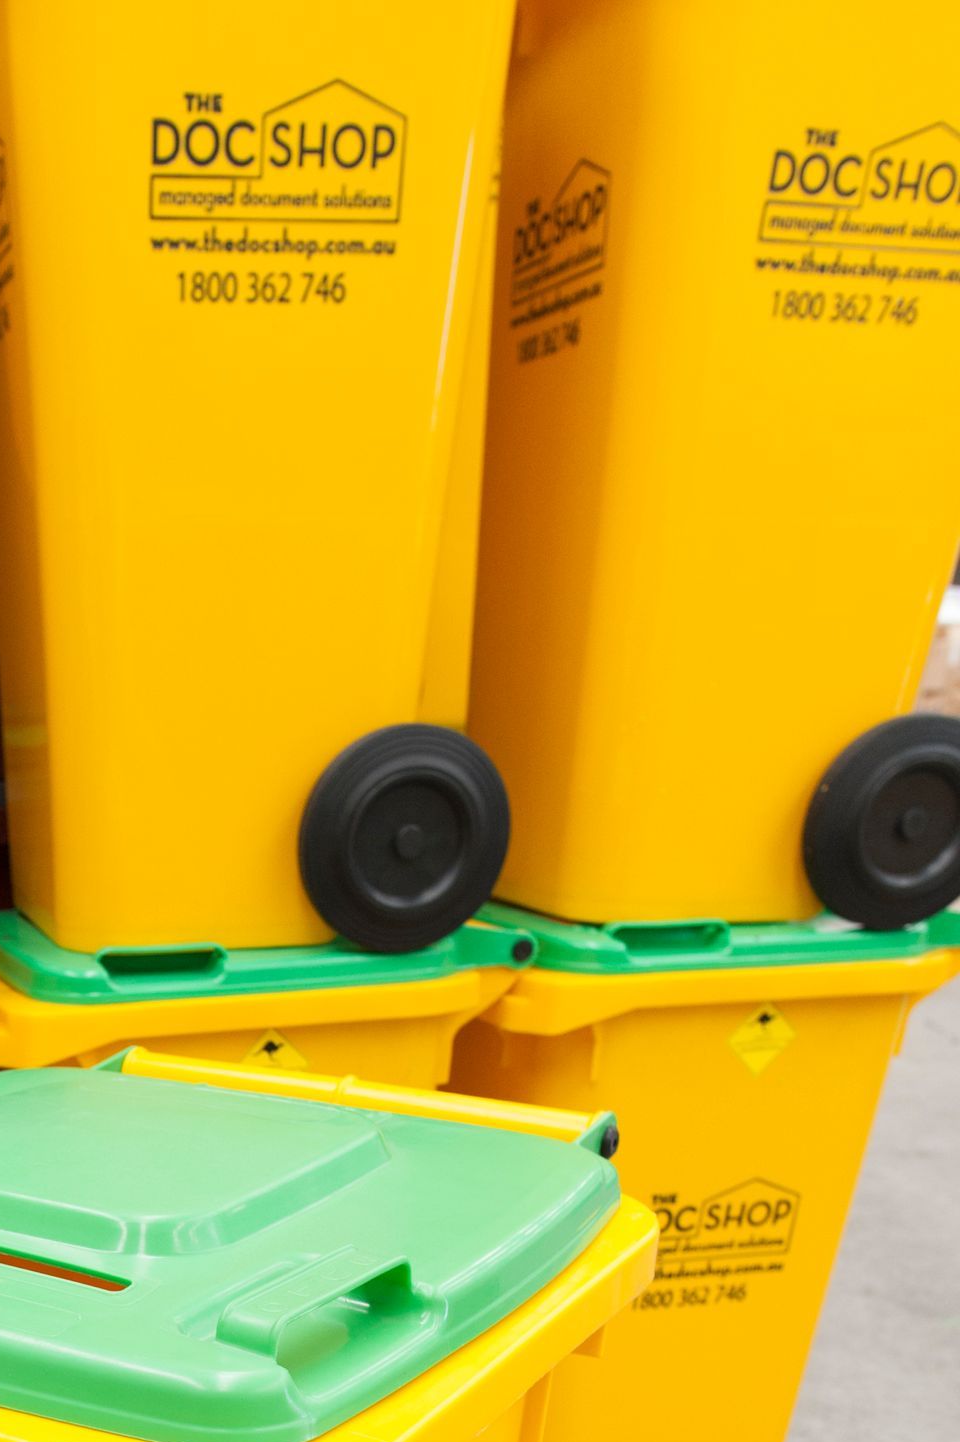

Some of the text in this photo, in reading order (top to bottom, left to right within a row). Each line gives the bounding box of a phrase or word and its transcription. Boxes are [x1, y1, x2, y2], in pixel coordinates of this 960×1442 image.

[184, 92, 223, 113] THE
[152, 119, 396, 169] DOC SHOP
[806, 128, 839, 147] THE
[769, 149, 960, 204] DOC SHO
[159, 178, 391, 212] managed document solutions
[150, 225, 396, 260] www.thedocshop.com.au
[178, 272, 347, 303] 1800 362 746
[773, 289, 919, 326] 1800 362 746
[657, 1199, 792, 1234] OC SHOP
